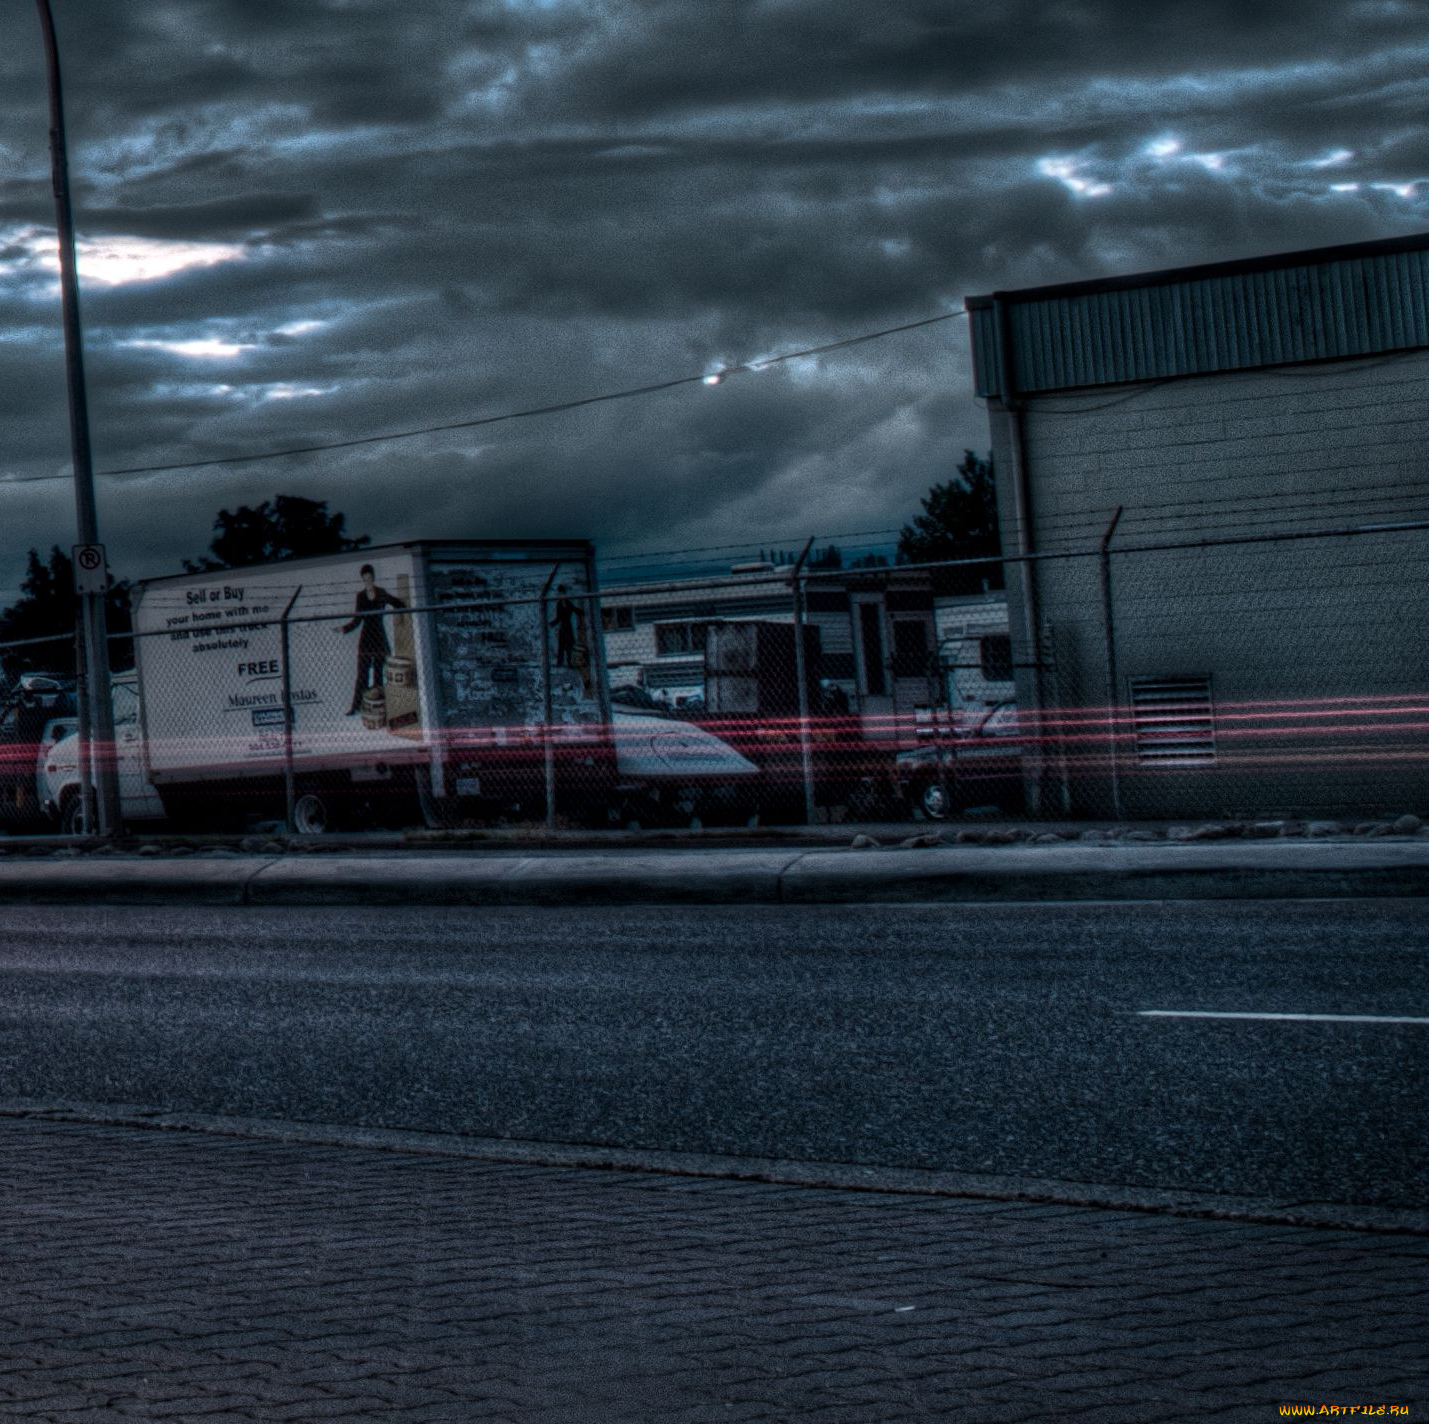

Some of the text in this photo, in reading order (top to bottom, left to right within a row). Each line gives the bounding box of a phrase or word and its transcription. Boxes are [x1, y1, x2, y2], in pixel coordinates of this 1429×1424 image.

[186, 586, 245, 605] Sell or Buy
[166, 604, 270, 628] your home with me
[192, 638, 249, 653] absolutely
[238, 659, 279, 676] FREE
